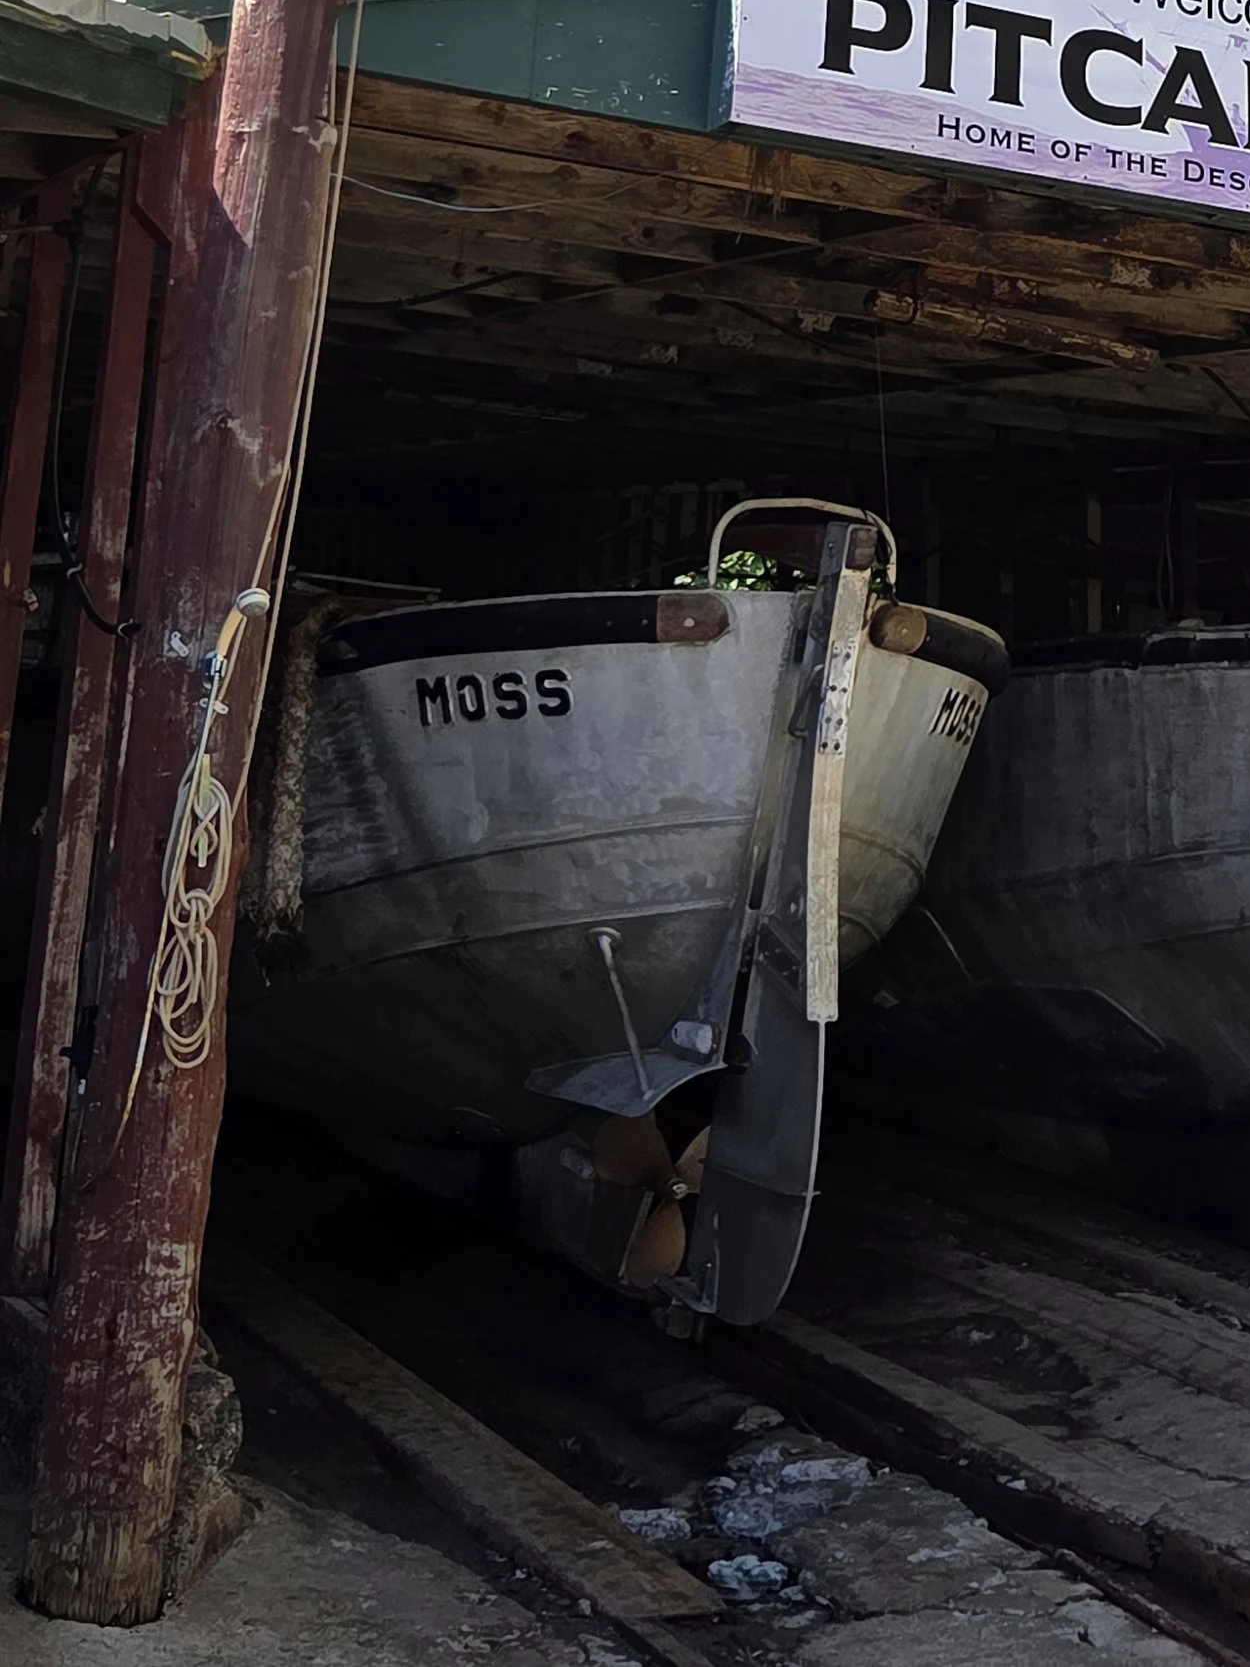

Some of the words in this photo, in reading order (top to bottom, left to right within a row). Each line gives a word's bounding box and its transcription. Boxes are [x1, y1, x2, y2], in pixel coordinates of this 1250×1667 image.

[937, 113, 1035, 154] HOME
[1051, 138, 1092, 162] OF
[1106, 149, 1167, 178] THE
[416, 669, 573, 727] MOSS
[929, 688, 982, 746] MOSS
